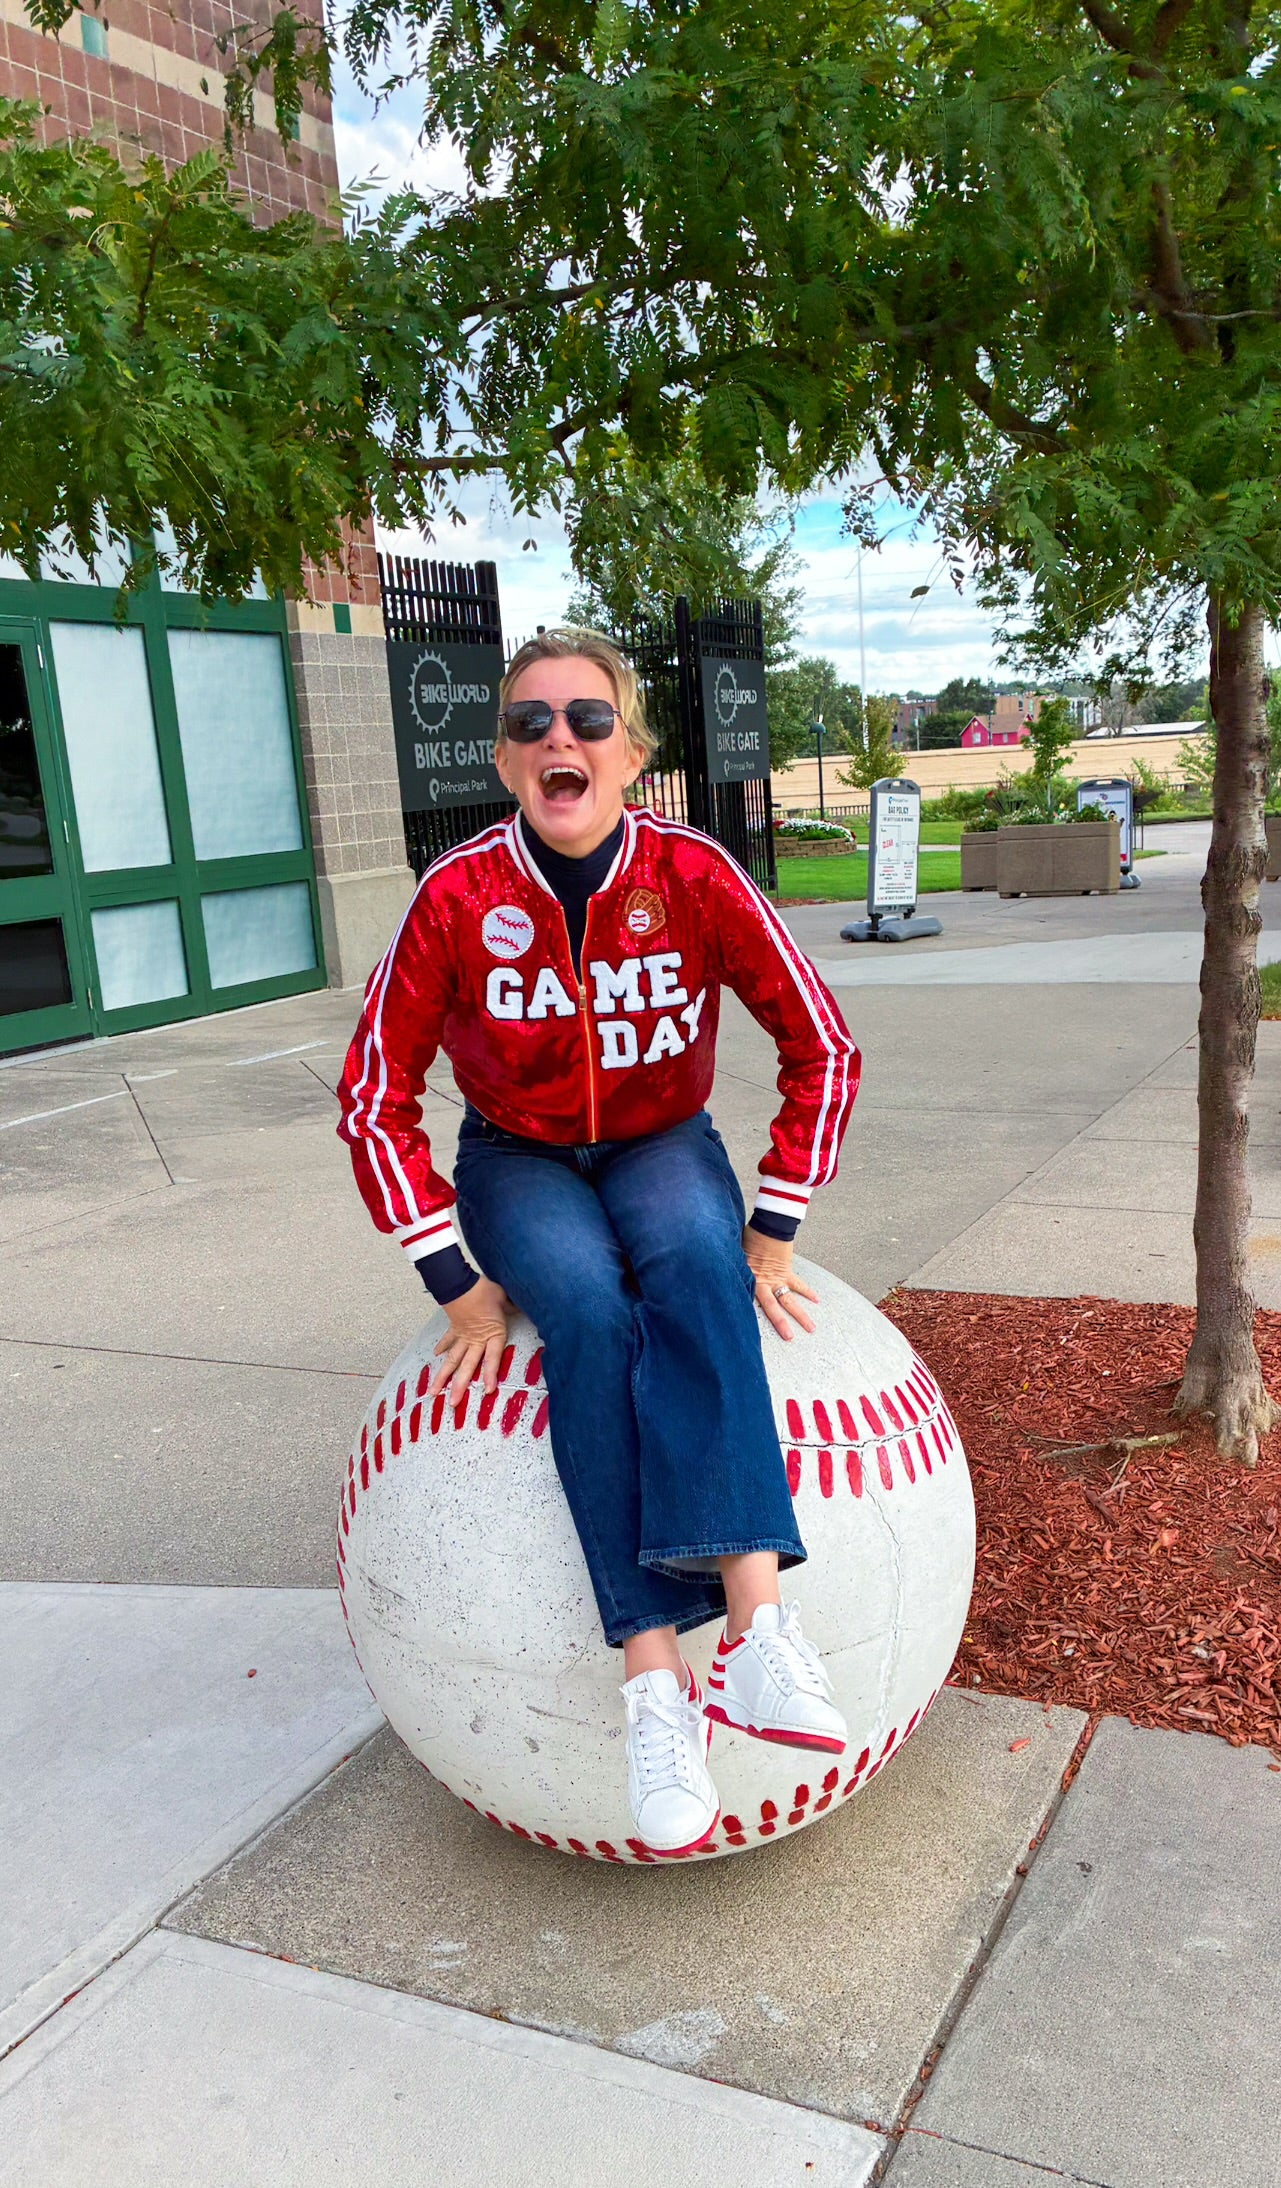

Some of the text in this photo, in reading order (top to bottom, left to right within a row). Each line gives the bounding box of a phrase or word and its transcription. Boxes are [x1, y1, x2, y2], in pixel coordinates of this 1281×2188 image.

[414, 739, 496, 769] BIKE GATE
[717, 731, 760, 752] BIKE GATE
[440, 778, 488, 795] Principal Park
[597, 987, 707, 1070] DAY
